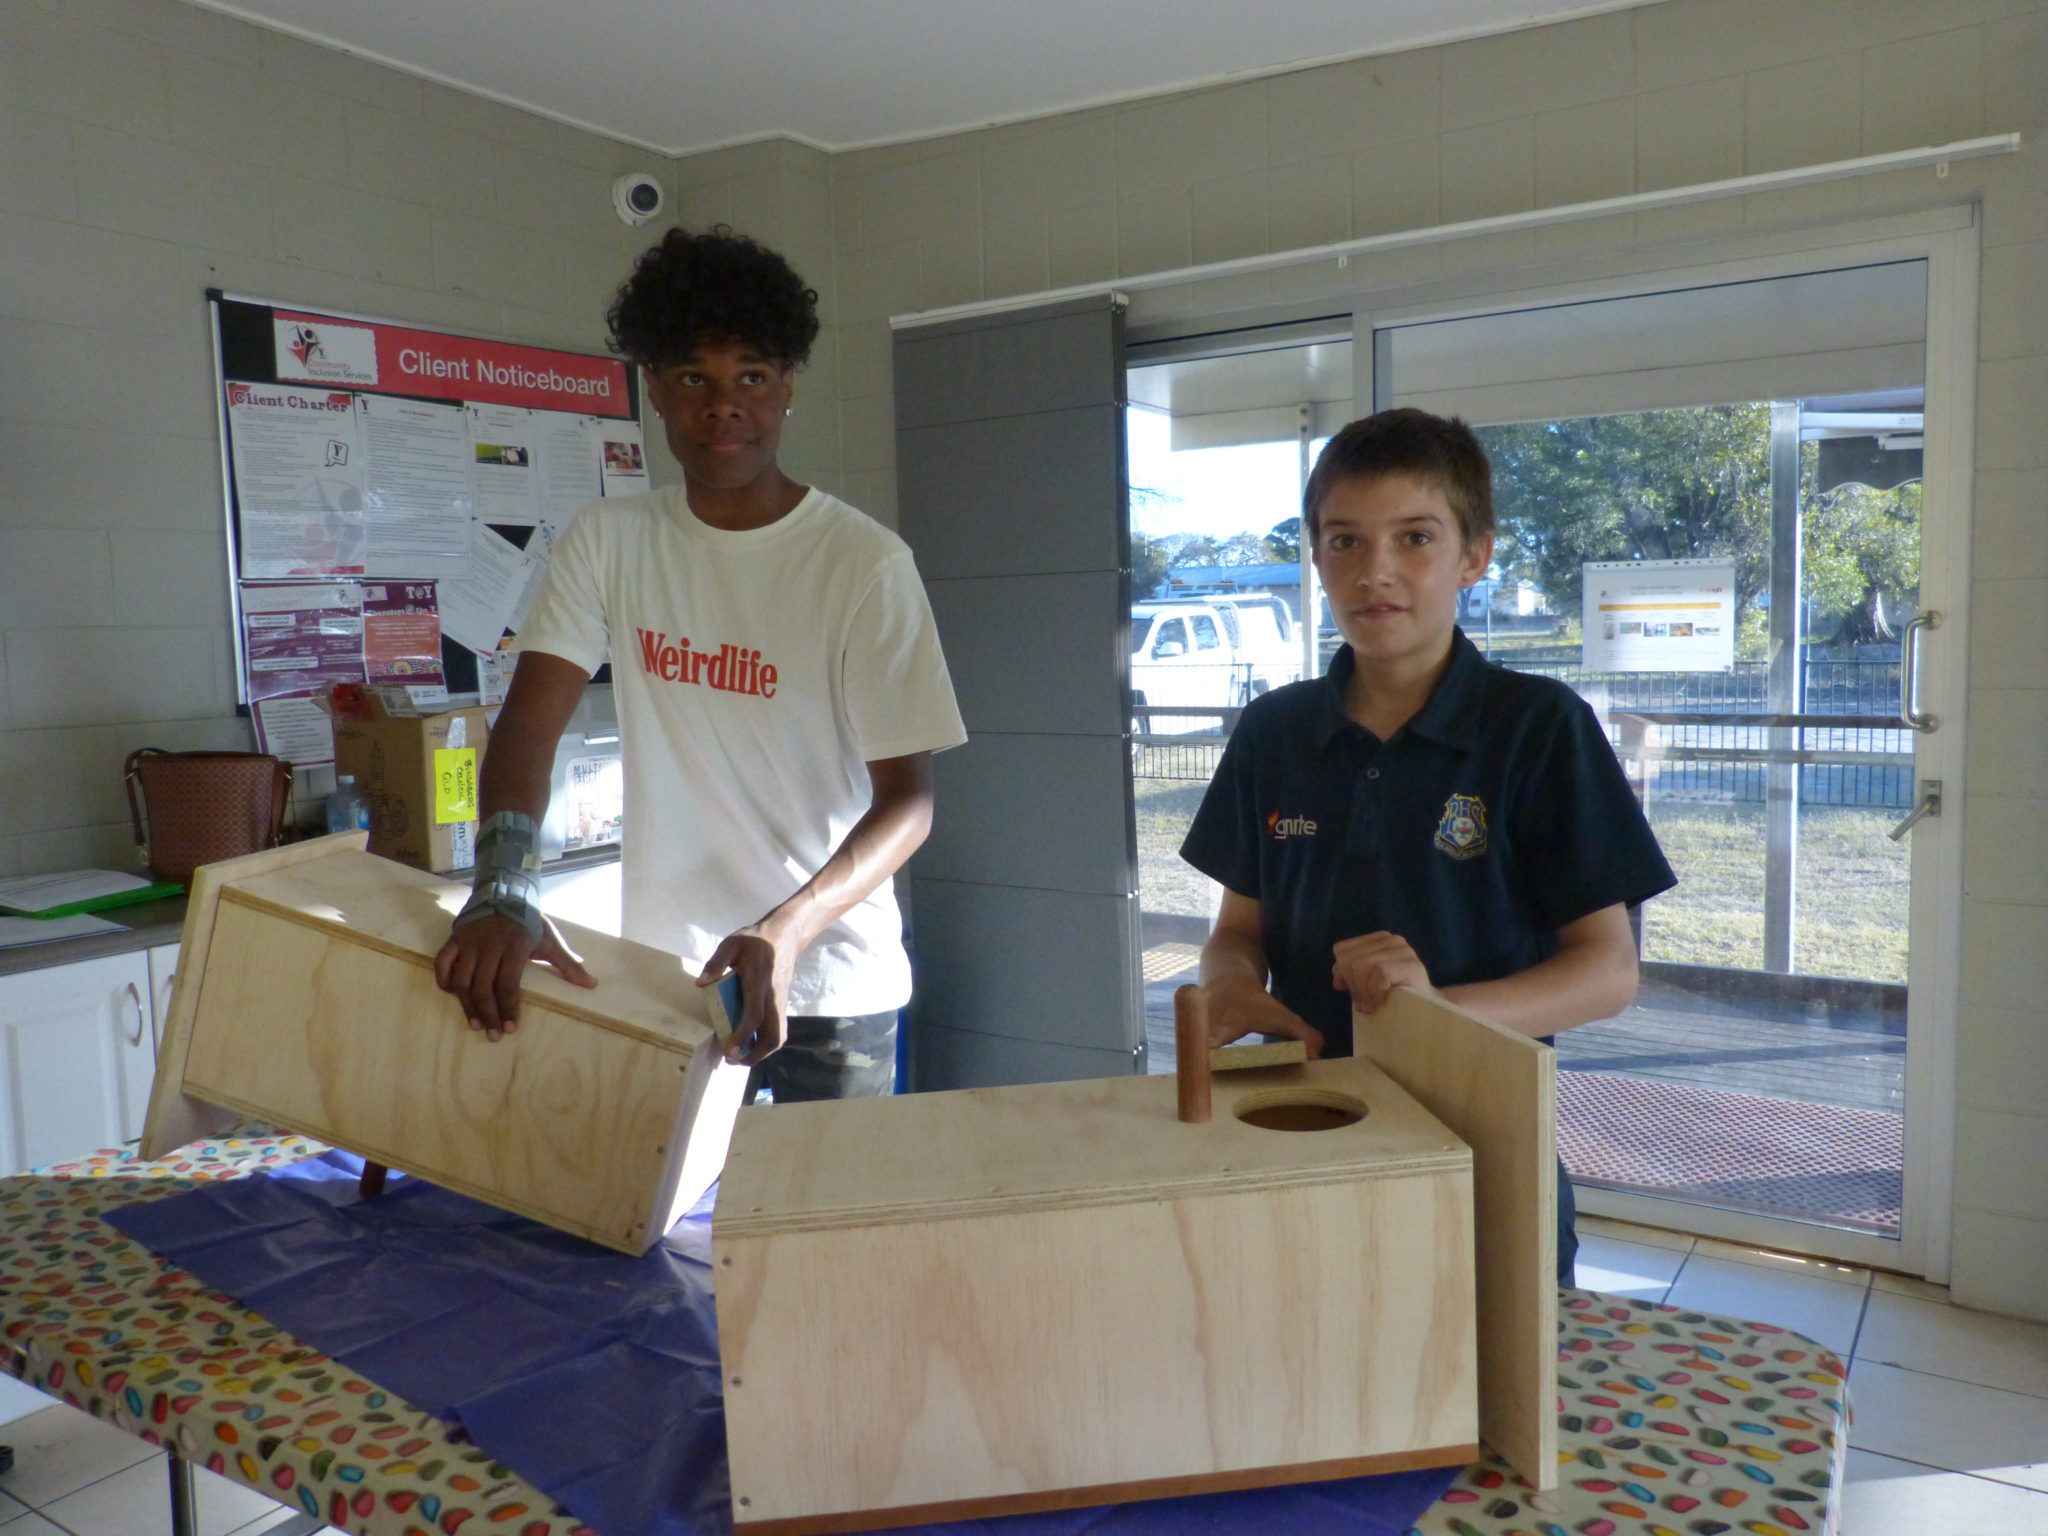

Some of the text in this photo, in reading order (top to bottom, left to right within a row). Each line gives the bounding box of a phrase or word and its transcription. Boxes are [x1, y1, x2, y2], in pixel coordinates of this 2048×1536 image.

[308, 368, 372, 380] Inclusion Services
[400, 349, 610, 397] Client Noticeboard
[234, 391, 347, 412] Client Charter
[636, 627, 778, 699] Weirdlife
